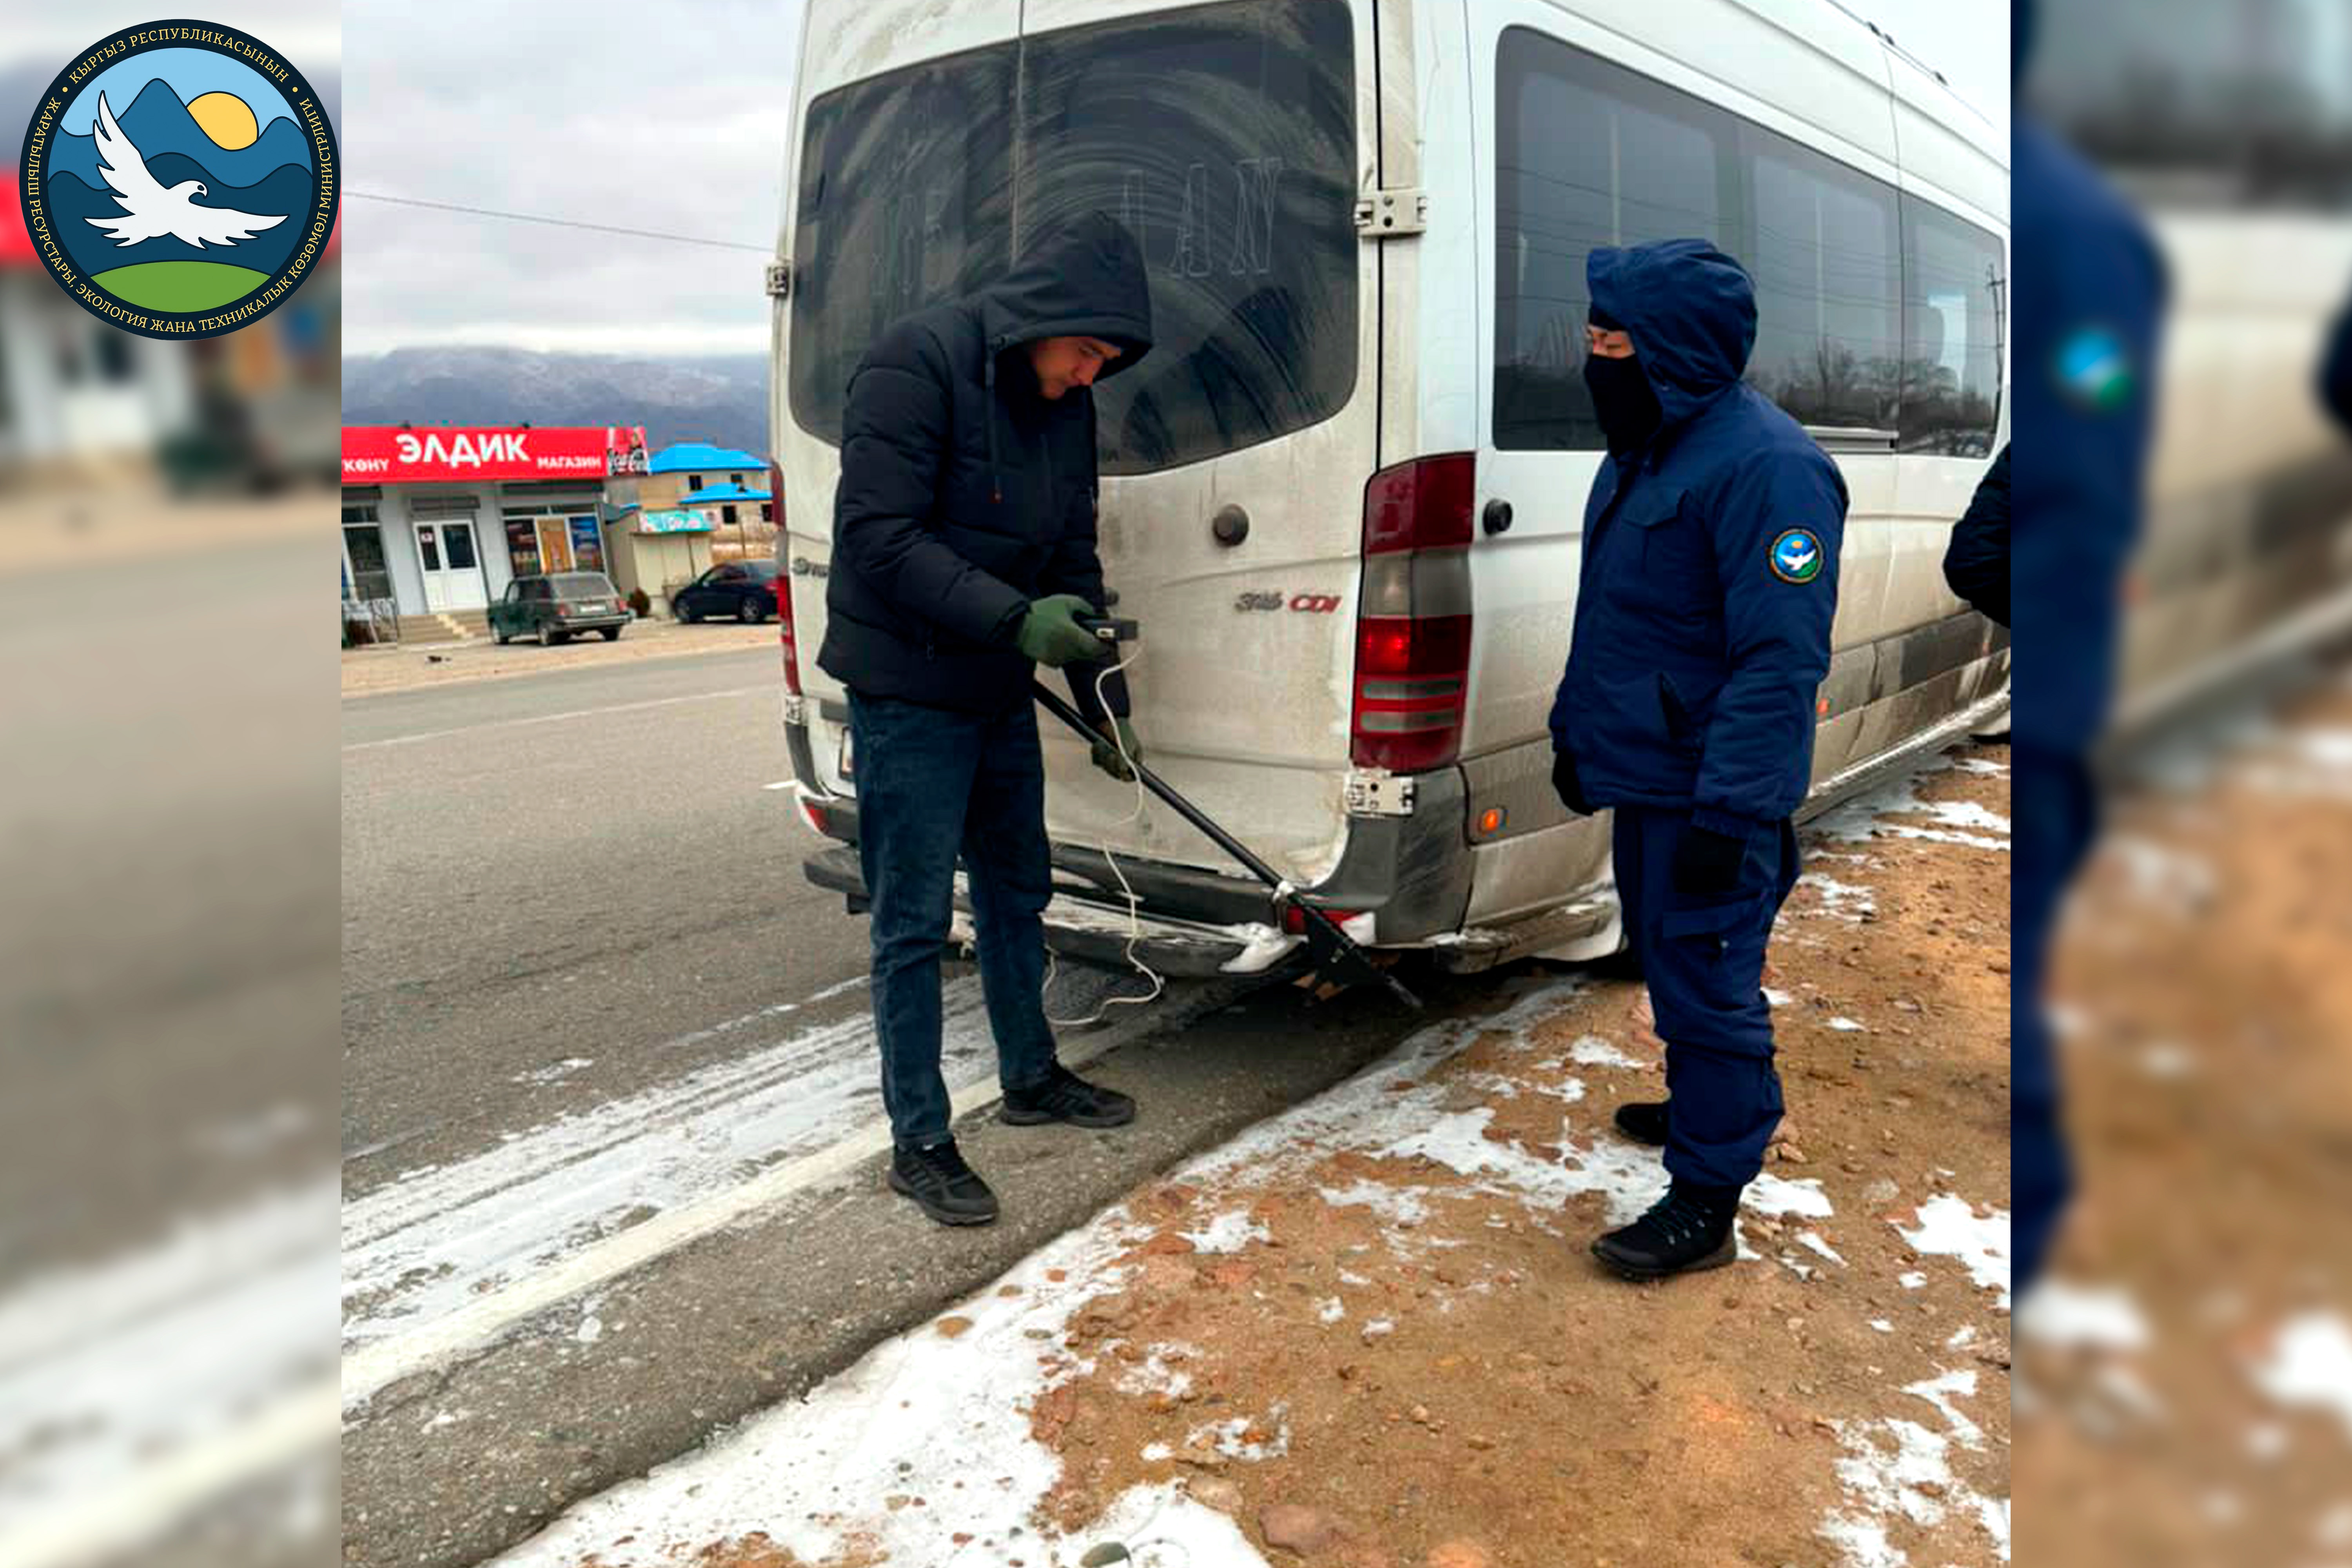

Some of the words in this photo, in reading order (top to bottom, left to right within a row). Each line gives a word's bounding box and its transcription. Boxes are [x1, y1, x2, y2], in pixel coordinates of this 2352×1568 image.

[396, 434, 531, 468] ЭЛДИК
[537, 456, 601, 469] МАГАЗИН
[1290, 595, 1343, 613] CDI
